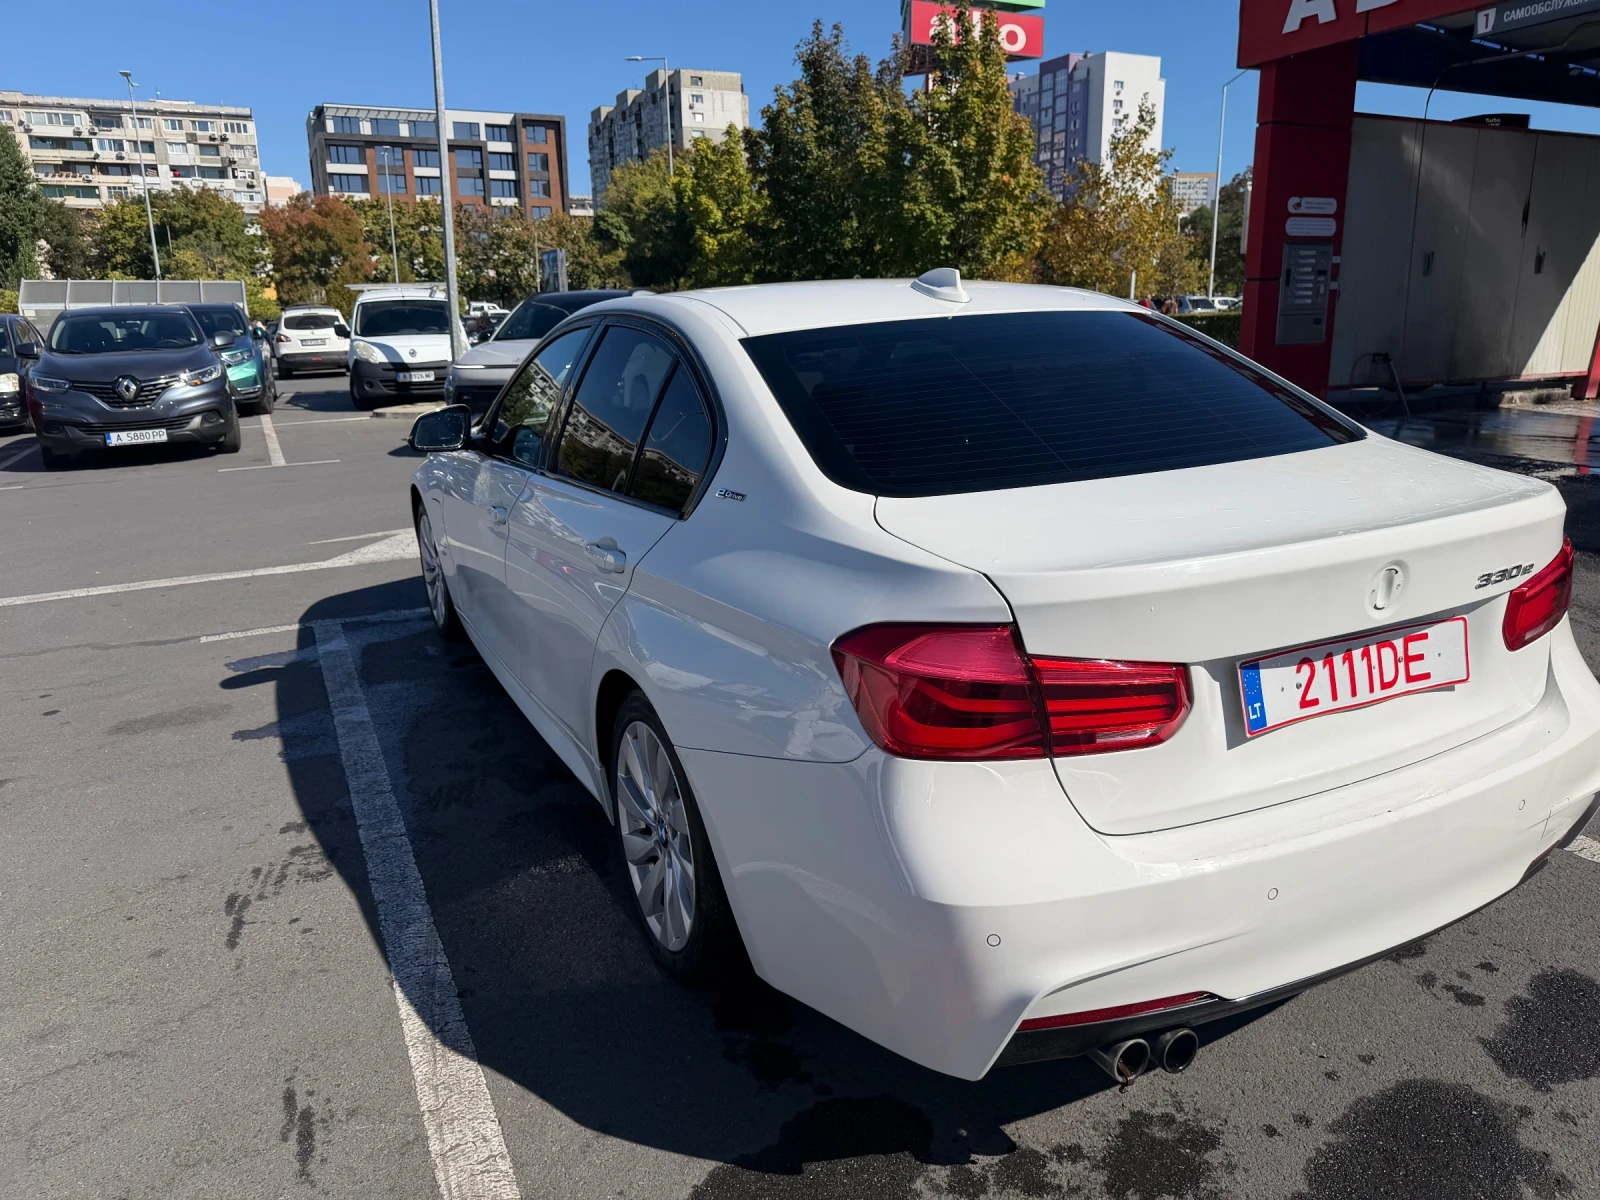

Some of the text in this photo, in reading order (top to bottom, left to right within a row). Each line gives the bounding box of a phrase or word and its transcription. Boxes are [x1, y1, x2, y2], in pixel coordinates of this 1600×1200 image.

[1483, 13, 1490, 30] 1
[1475, 563, 1535, 590] 330e
[1248, 632, 1432, 720] LT 2111DE
